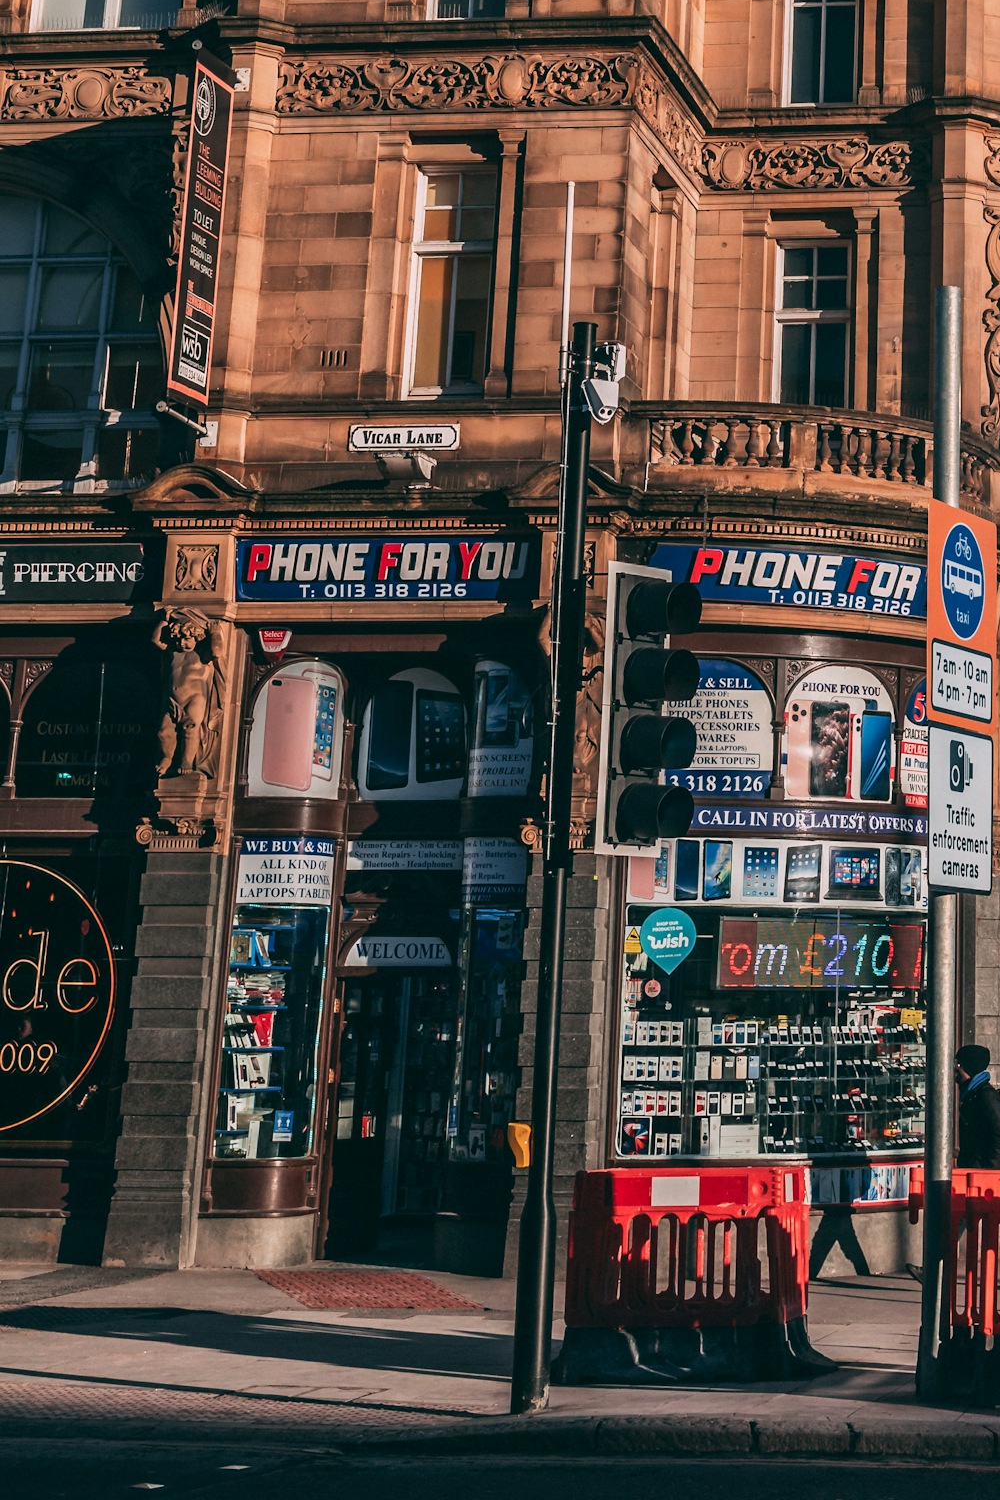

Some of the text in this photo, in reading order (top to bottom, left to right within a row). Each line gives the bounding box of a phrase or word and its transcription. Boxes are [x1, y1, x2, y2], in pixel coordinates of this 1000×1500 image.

[199, 141, 211, 159] THE
[196, 160, 222, 187] LEEMING
[195, 181, 221, 207] BUILDING
[193, 208, 213, 231] TO LET
[182, 331, 202, 361] wsb
[363, 430, 443, 444] VICAR LANE
[247, 542, 529, 581] PHONE FOR YOU
[13, 562, 145, 583] PIERCING
[690, 549, 921, 600] PHONE FOR
[299, 583, 467, 598] T: 0113 318 2126
[768, 590, 911, 615] T: 0113 318 2126
[956, 608, 970, 625] taxi
[936, 652, 988, 684] 7 am 10 am
[705, 678, 716, 688] &
[719, 678, 753, 689] SELL
[802, 681, 881, 696] PHONE FOR YOU
[937, 678, 987, 709] 4 pm 7 pm
[667, 700, 749, 709] OBILE PHONES
[668, 711, 753, 719] PTOPS/TABLETS
[693, 722, 760, 731] CCESSORIES
[697, 733, 736, 743] WARES
[720, 756, 756, 765] TOPUPS
[481, 767, 525, 776] PROBLEM
[685, 775, 716, 792] 318
[722, 775, 763, 792] 2126
[698, 809, 746, 826] CALL
[750, 812, 768, 827] IN
[771, 812, 807, 829] FOR
[811, 813, 865, 831] LATEST
[868, 816, 914, 833] OFFERS
[915, 819, 924, 834] &
[946, 803, 975, 828] Traffic
[246, 841, 334, 854] WE BUY & SELL
[356, 841, 387, 850] Memory
[390, 841, 412, 849] Cards
[420, 841, 434, 849] Sim
[436, 841, 460, 849] Cards
[933, 829, 988, 855] enforcement
[354, 850, 379, 859] Screen
[382, 850, 411, 860] Repairs
[418, 850, 456, 860] Unlocking
[260, 859, 327, 871] ALL KIND OF
[407, 861, 453, 870] Headphones
[942, 860, 979, 879] cameras
[245, 873, 294, 884] MOBILE
[478, 873, 505, 881] Repairs
[240, 887, 330, 900] LAPTOPS/TABLETS
[647, 932, 690, 950] wish
[356, 943, 445, 960] WELCOME
[722, 943, 788, 976] rom
[2, 930, 99, 1014] de
[0, 1043, 57, 1073] 009
